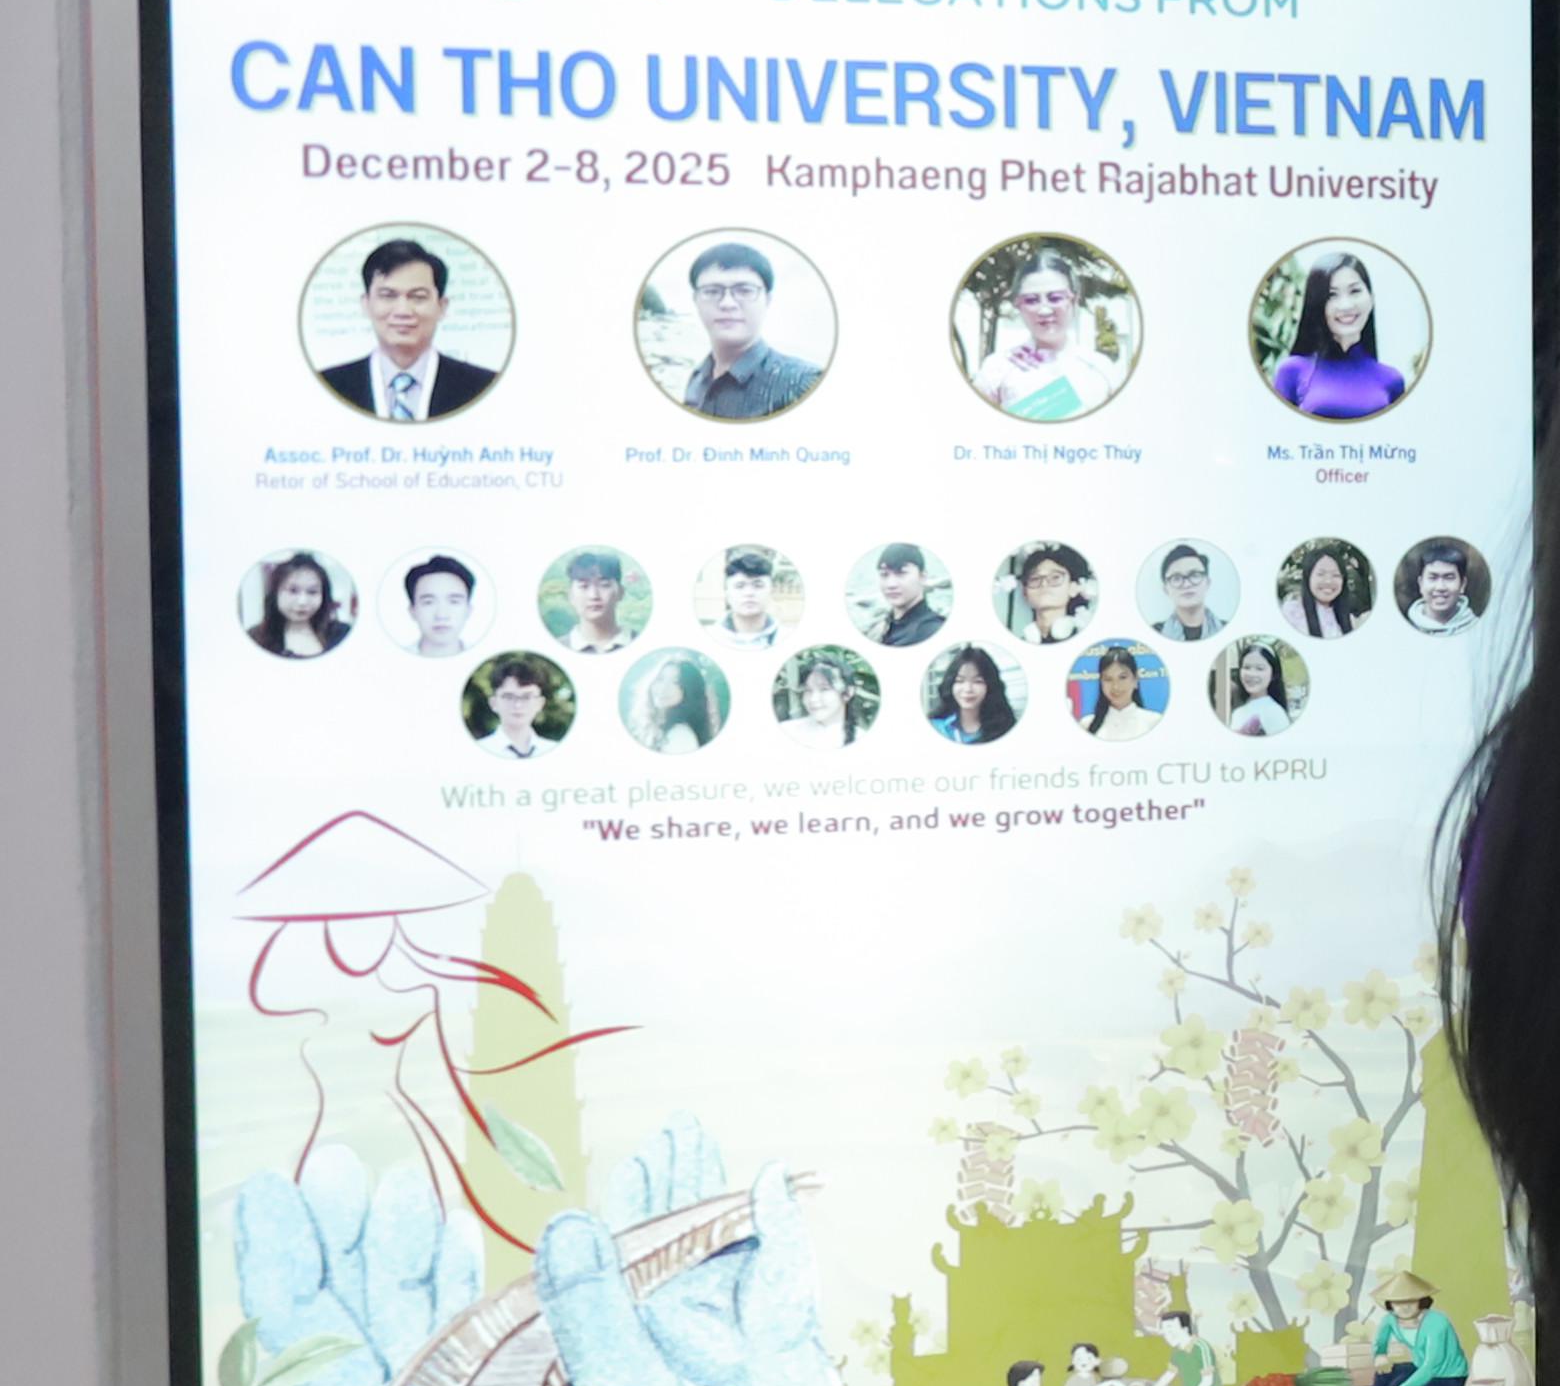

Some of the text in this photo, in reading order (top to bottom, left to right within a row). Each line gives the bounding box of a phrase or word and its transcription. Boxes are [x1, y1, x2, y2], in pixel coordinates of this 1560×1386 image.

[230, 39, 1488, 149] CAN THO UNIVERSITY, VIETNAM
[301, 143, 731, 192] December 2-8, 2025
[766, 154, 1439, 209] Kamphaeng Phet Rajabhat University
[264, 445, 554, 467] Assoc. Prof. Dr. Huỳnh Anh Huy
[625, 447, 665, 463] Prof.
[672, 447, 696, 463] Dr.
[749, 447, 790, 463] Minh
[796, 446, 851, 466] Quang
[953, 444, 1142, 464] Dr. Thái Thị Ngọc Thúy
[1267, 445, 1295, 461] Ms.
[1299, 443, 1335, 461] Trần
[1340, 444, 1365, 463] Thị
[312, 471, 328, 489] of
[335, 471, 398, 489] School
[403, 471, 421, 489] of
[427, 471, 521, 491] Education,
[525, 470, 564, 489] CTU
[1316, 468, 1370, 484] Officer
[440, 758, 1328, 812] With a great pleasure, we welcome our friends from CTU to KPRU
[582, 798, 1206, 842] "We share, we learn, and we grow together"
